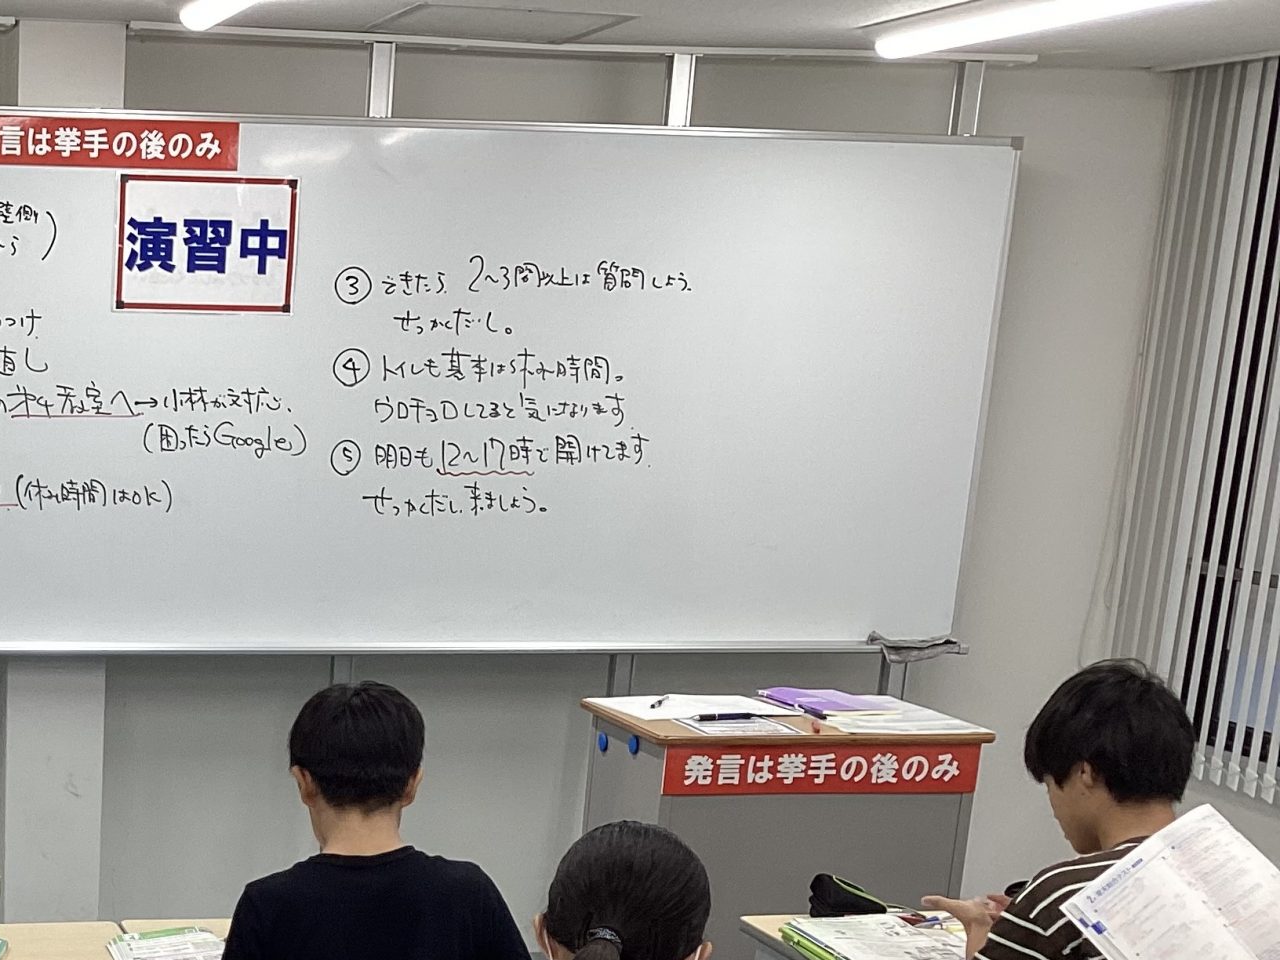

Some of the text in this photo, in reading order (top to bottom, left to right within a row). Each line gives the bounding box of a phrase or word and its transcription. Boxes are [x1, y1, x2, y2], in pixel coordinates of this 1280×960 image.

[125, 217, 287, 275] 演習中
[684, 753, 961, 786] 発言は挙手の後のみ
